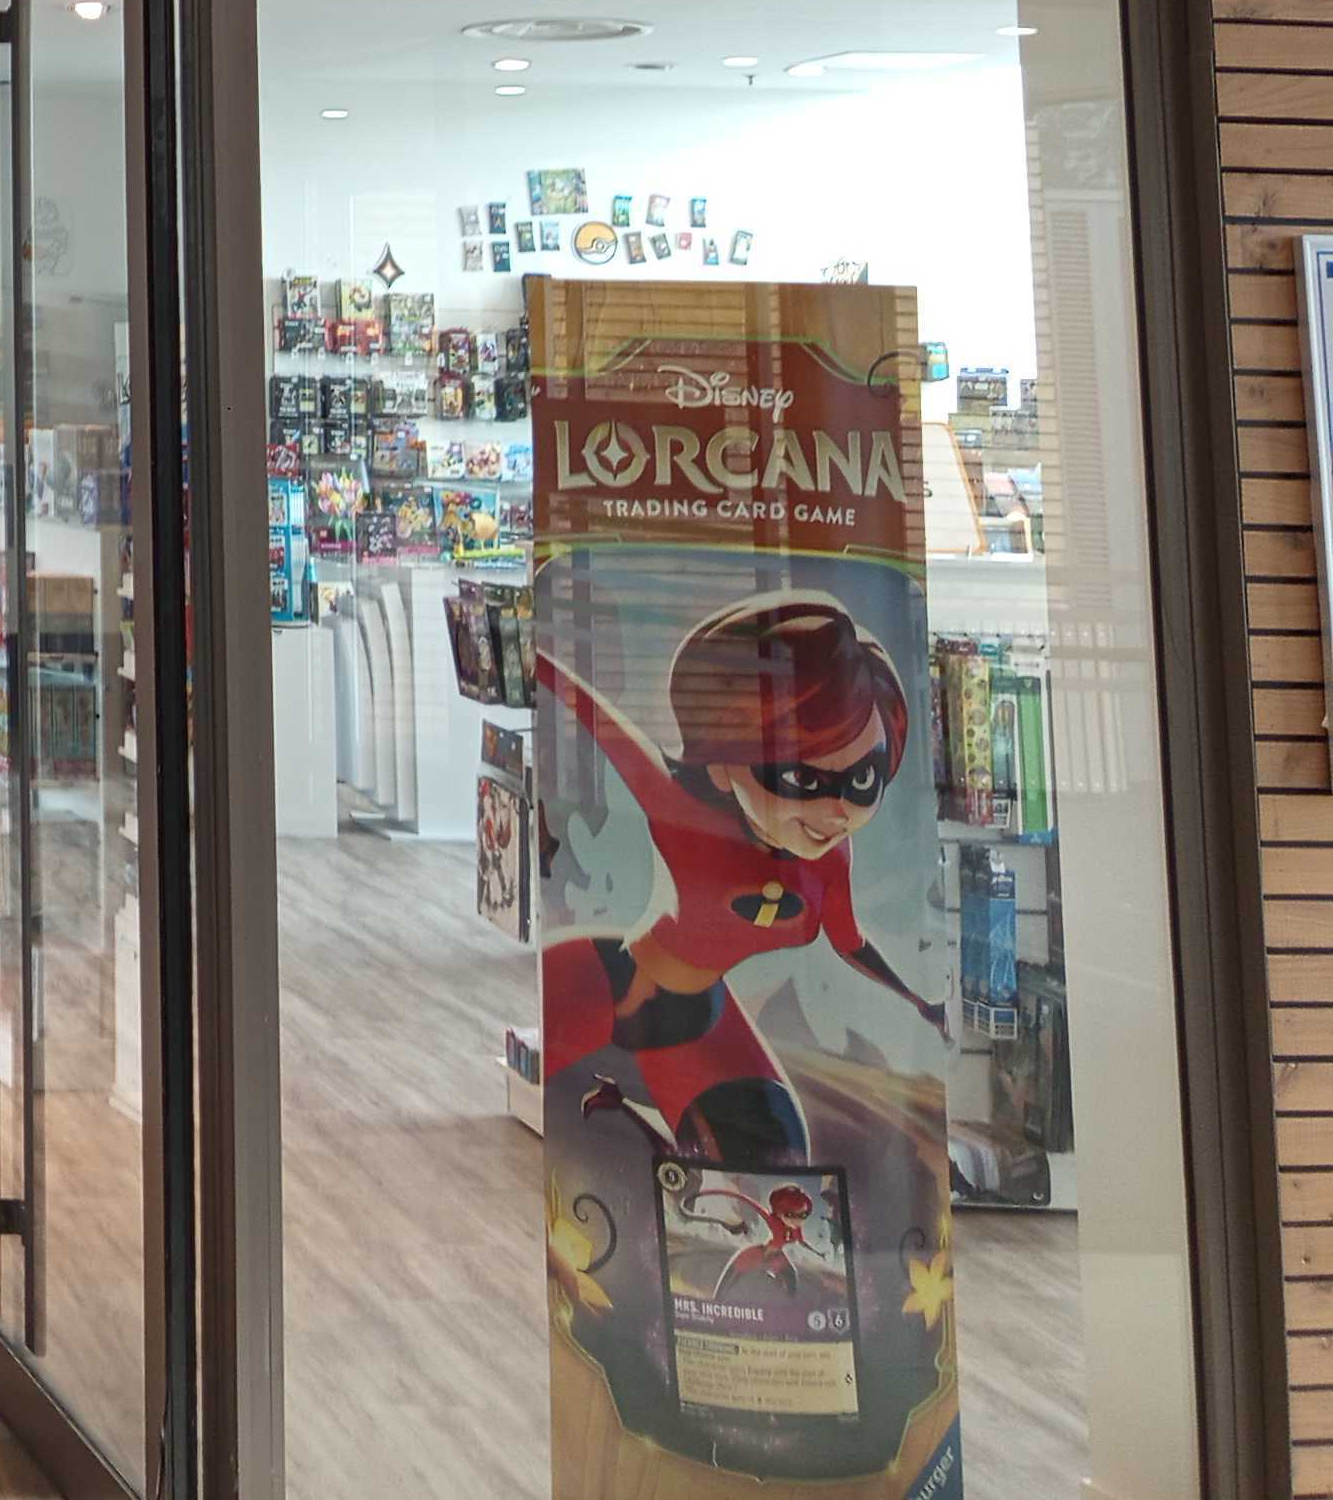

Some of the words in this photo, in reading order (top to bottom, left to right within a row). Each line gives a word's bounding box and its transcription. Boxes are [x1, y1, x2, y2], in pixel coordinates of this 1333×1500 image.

[553, 419, 907, 503] LORCANA
[603, 499, 708, 518] TRADING
[716, 499, 785, 521] CARD
[794, 504, 856, 527] GAME
[674, 1298, 698, 1313] MRS.
[702, 1302, 764, 1322] INCREDIBLE
